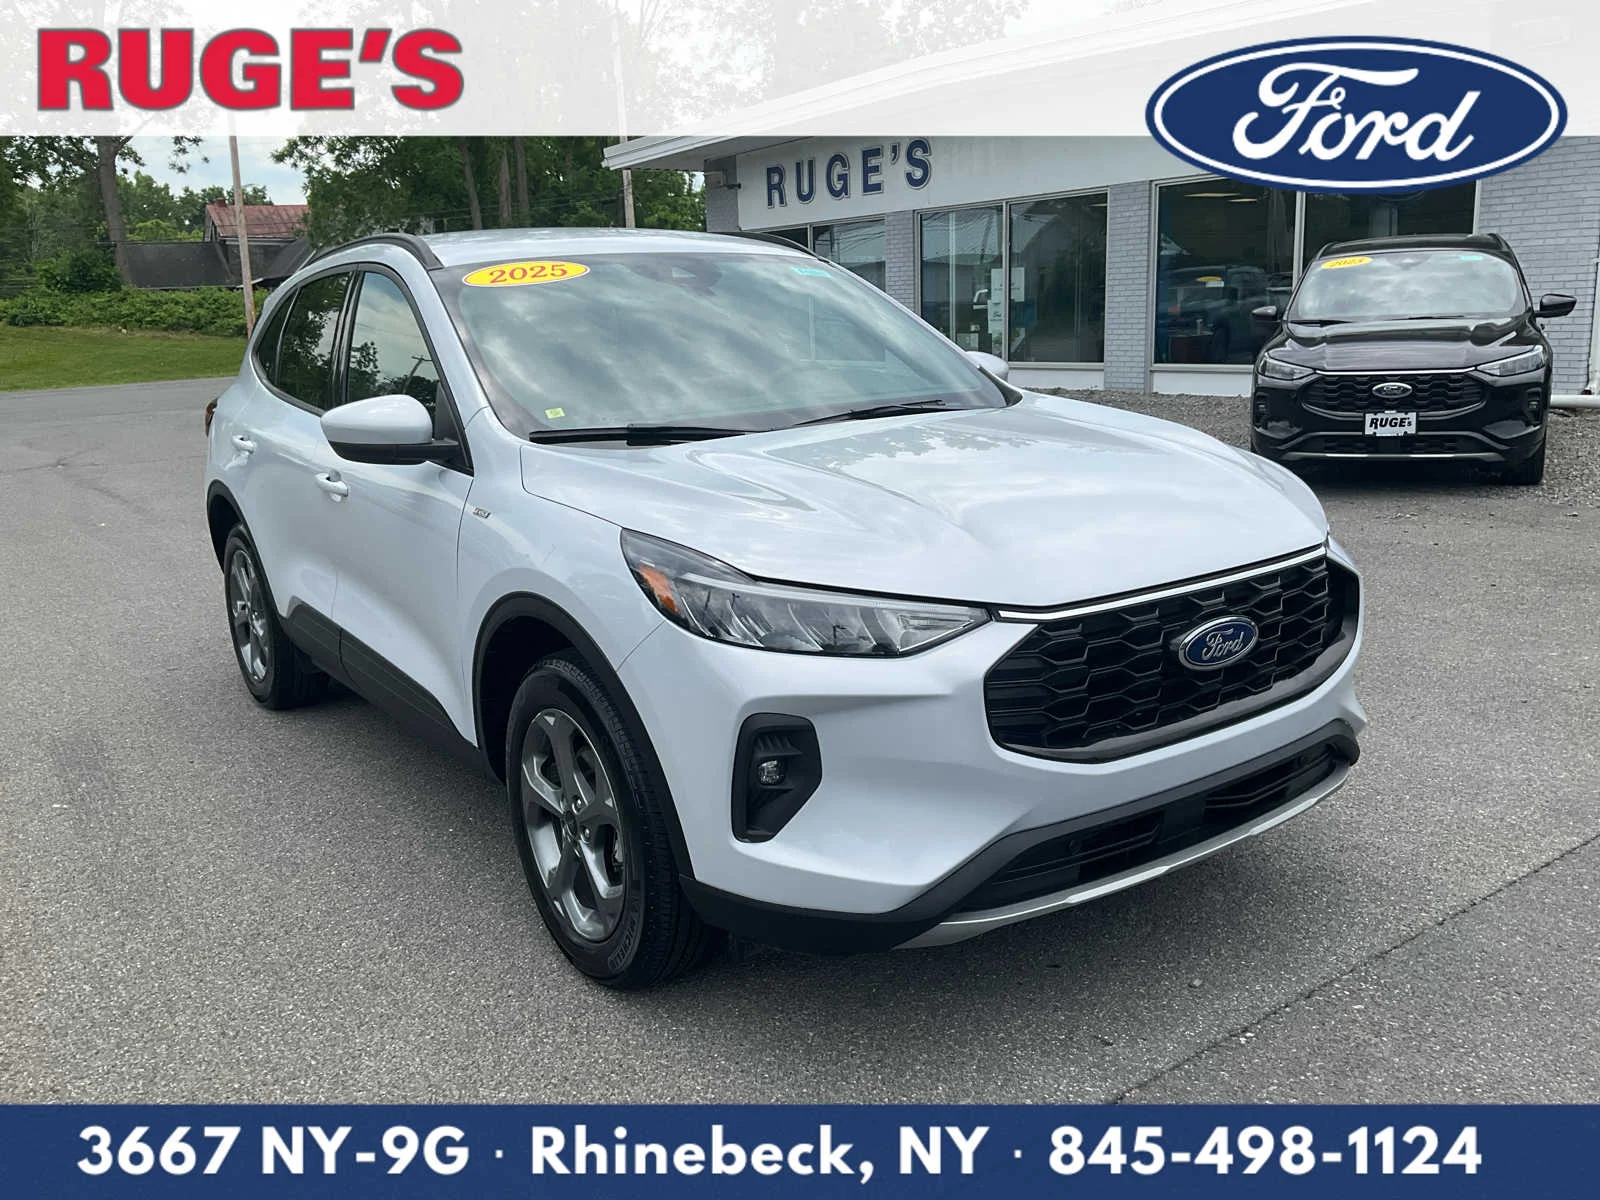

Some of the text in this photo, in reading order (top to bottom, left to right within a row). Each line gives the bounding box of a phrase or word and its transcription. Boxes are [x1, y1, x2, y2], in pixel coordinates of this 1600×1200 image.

[766, 139, 931, 207] RUGE'S
[489, 264, 568, 284] 2025
[1202, 628, 1245, 660] Ford
